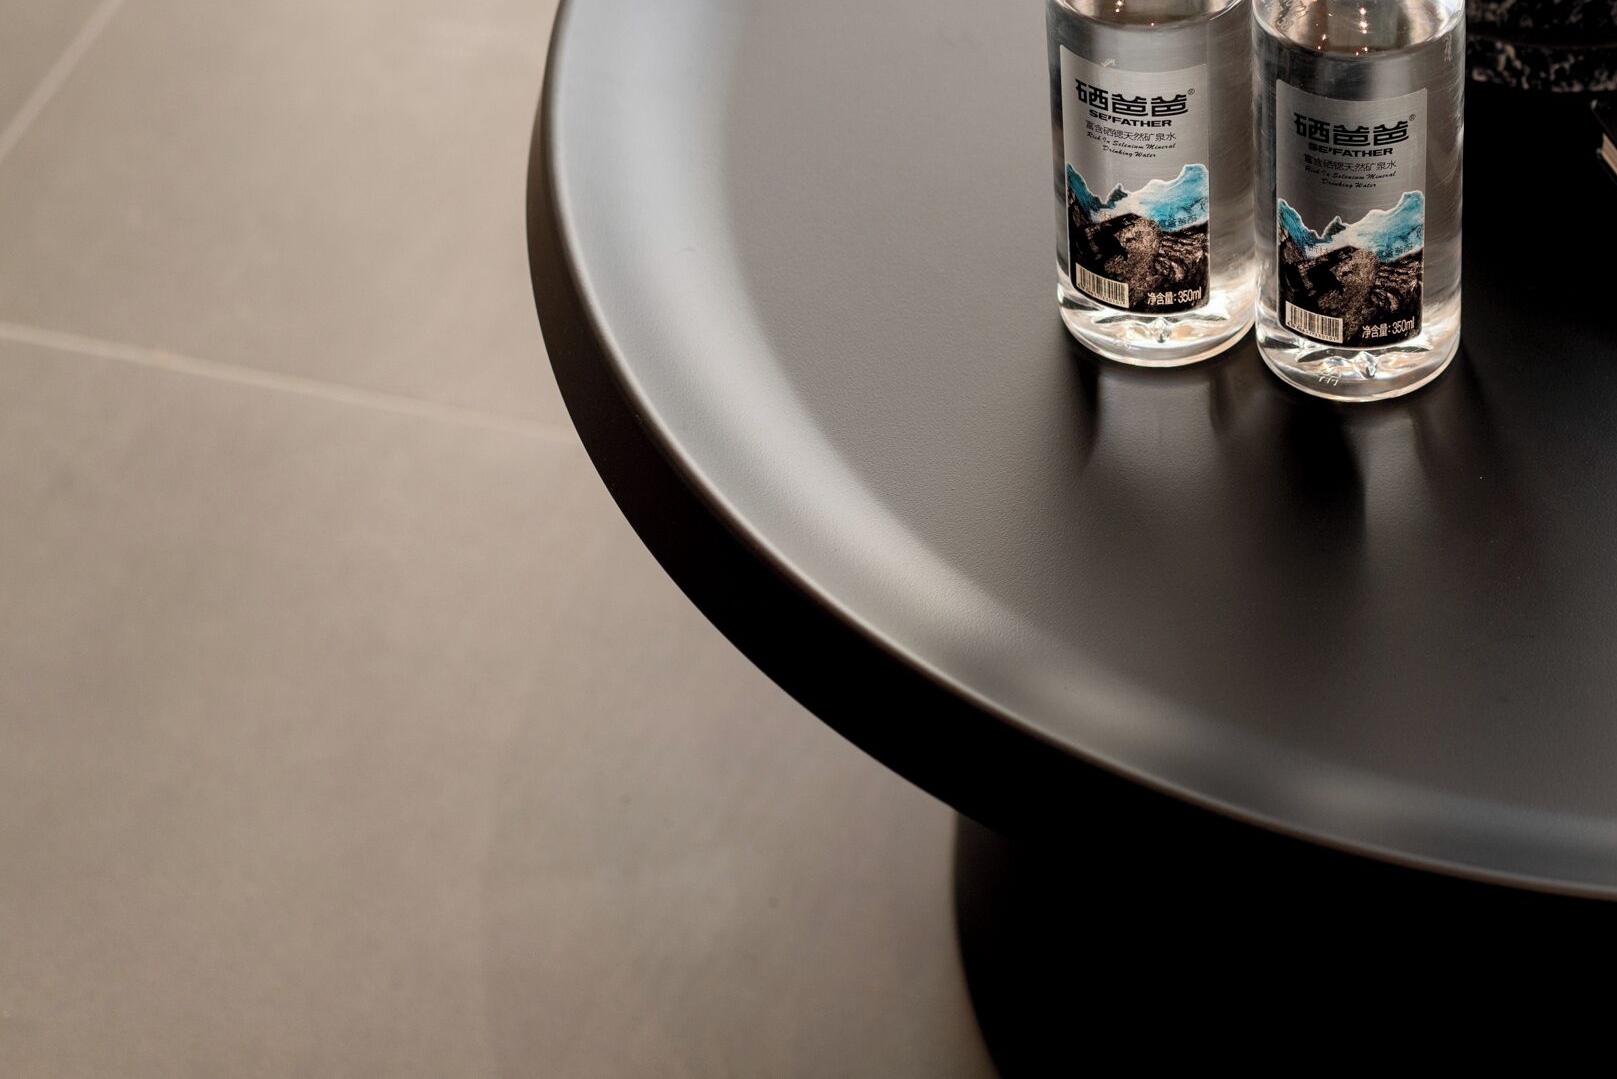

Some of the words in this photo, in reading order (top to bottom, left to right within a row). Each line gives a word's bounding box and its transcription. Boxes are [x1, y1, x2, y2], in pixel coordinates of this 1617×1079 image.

[1089, 109, 1172, 127] SE'FATHER
[1112, 140, 1144, 150] Selenium
[1145, 142, 1177, 150] Mineral
